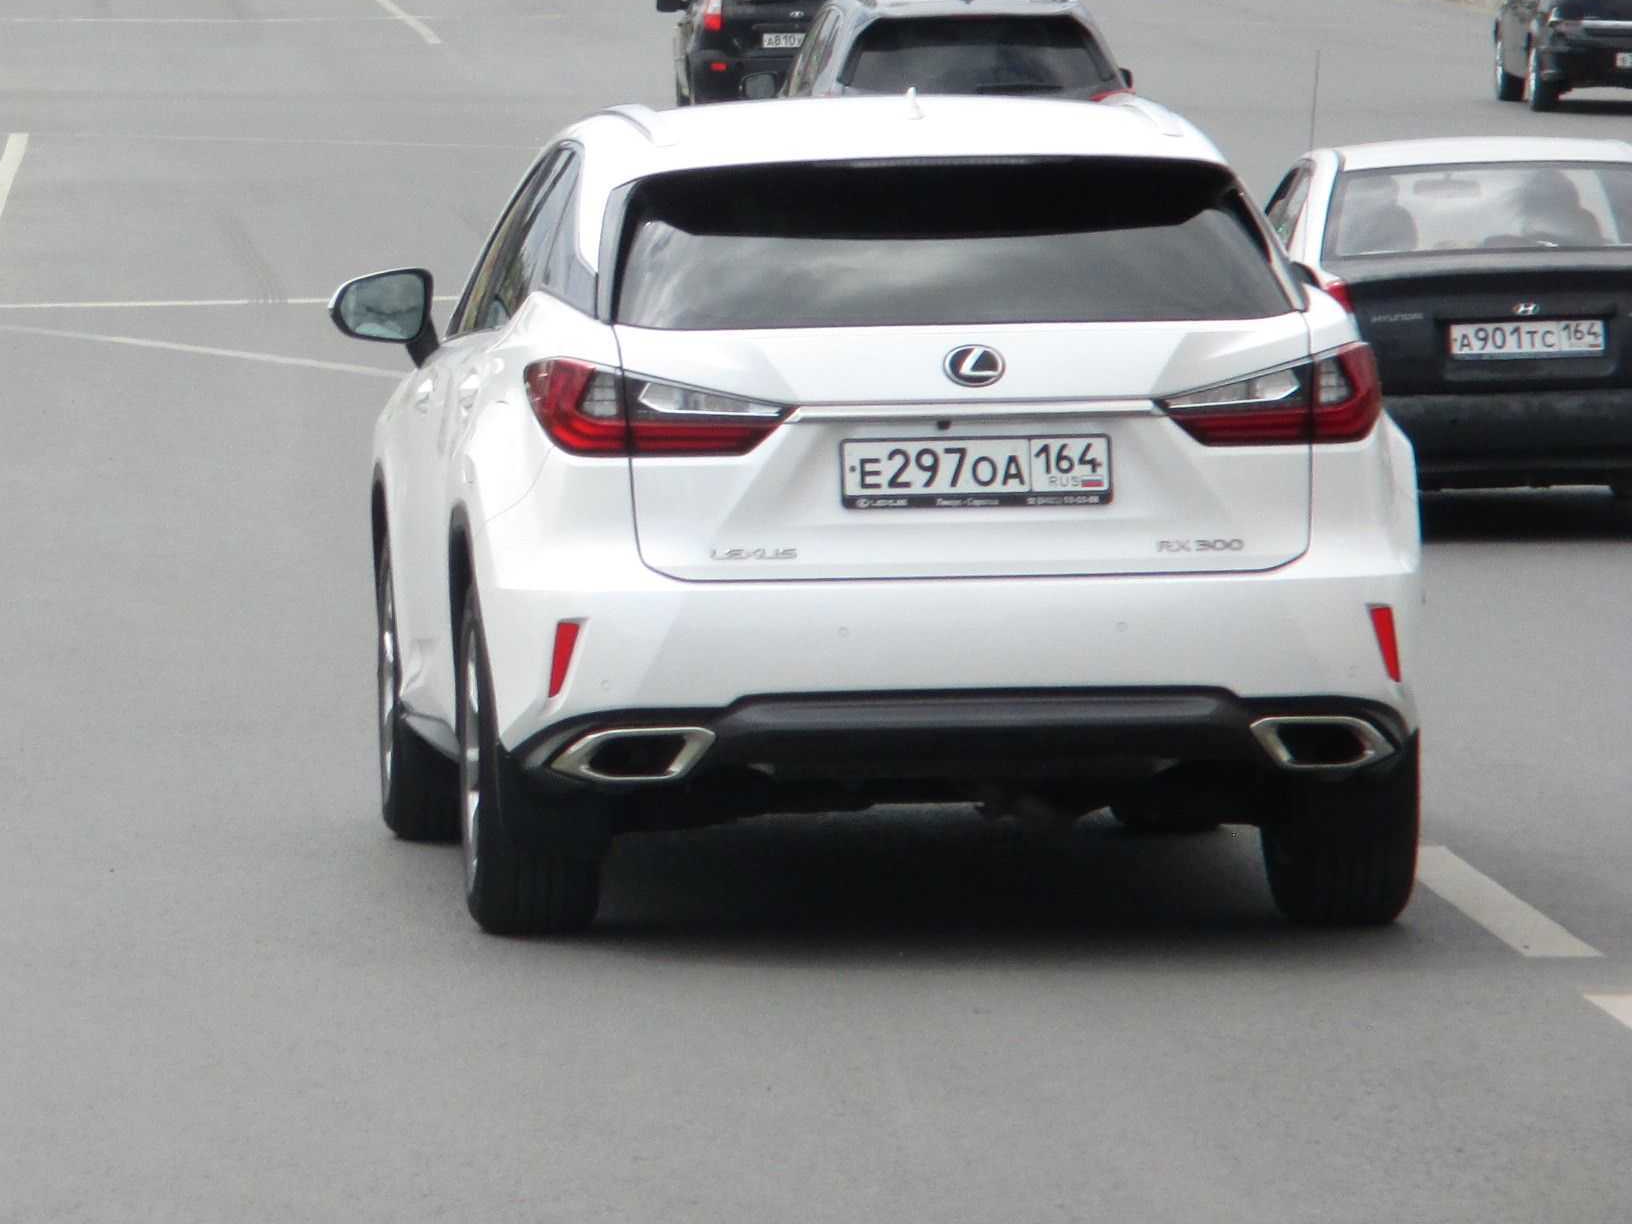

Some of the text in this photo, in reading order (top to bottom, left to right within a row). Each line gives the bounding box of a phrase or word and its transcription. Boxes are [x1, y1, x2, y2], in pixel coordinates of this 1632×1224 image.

[1458, 323, 1600, 352] А901ТС 164
[858, 442, 1103, 489] Е297ОА 164
[1048, 476, 1080, 487] RUS
[1157, 538, 1245, 553] RX 300
